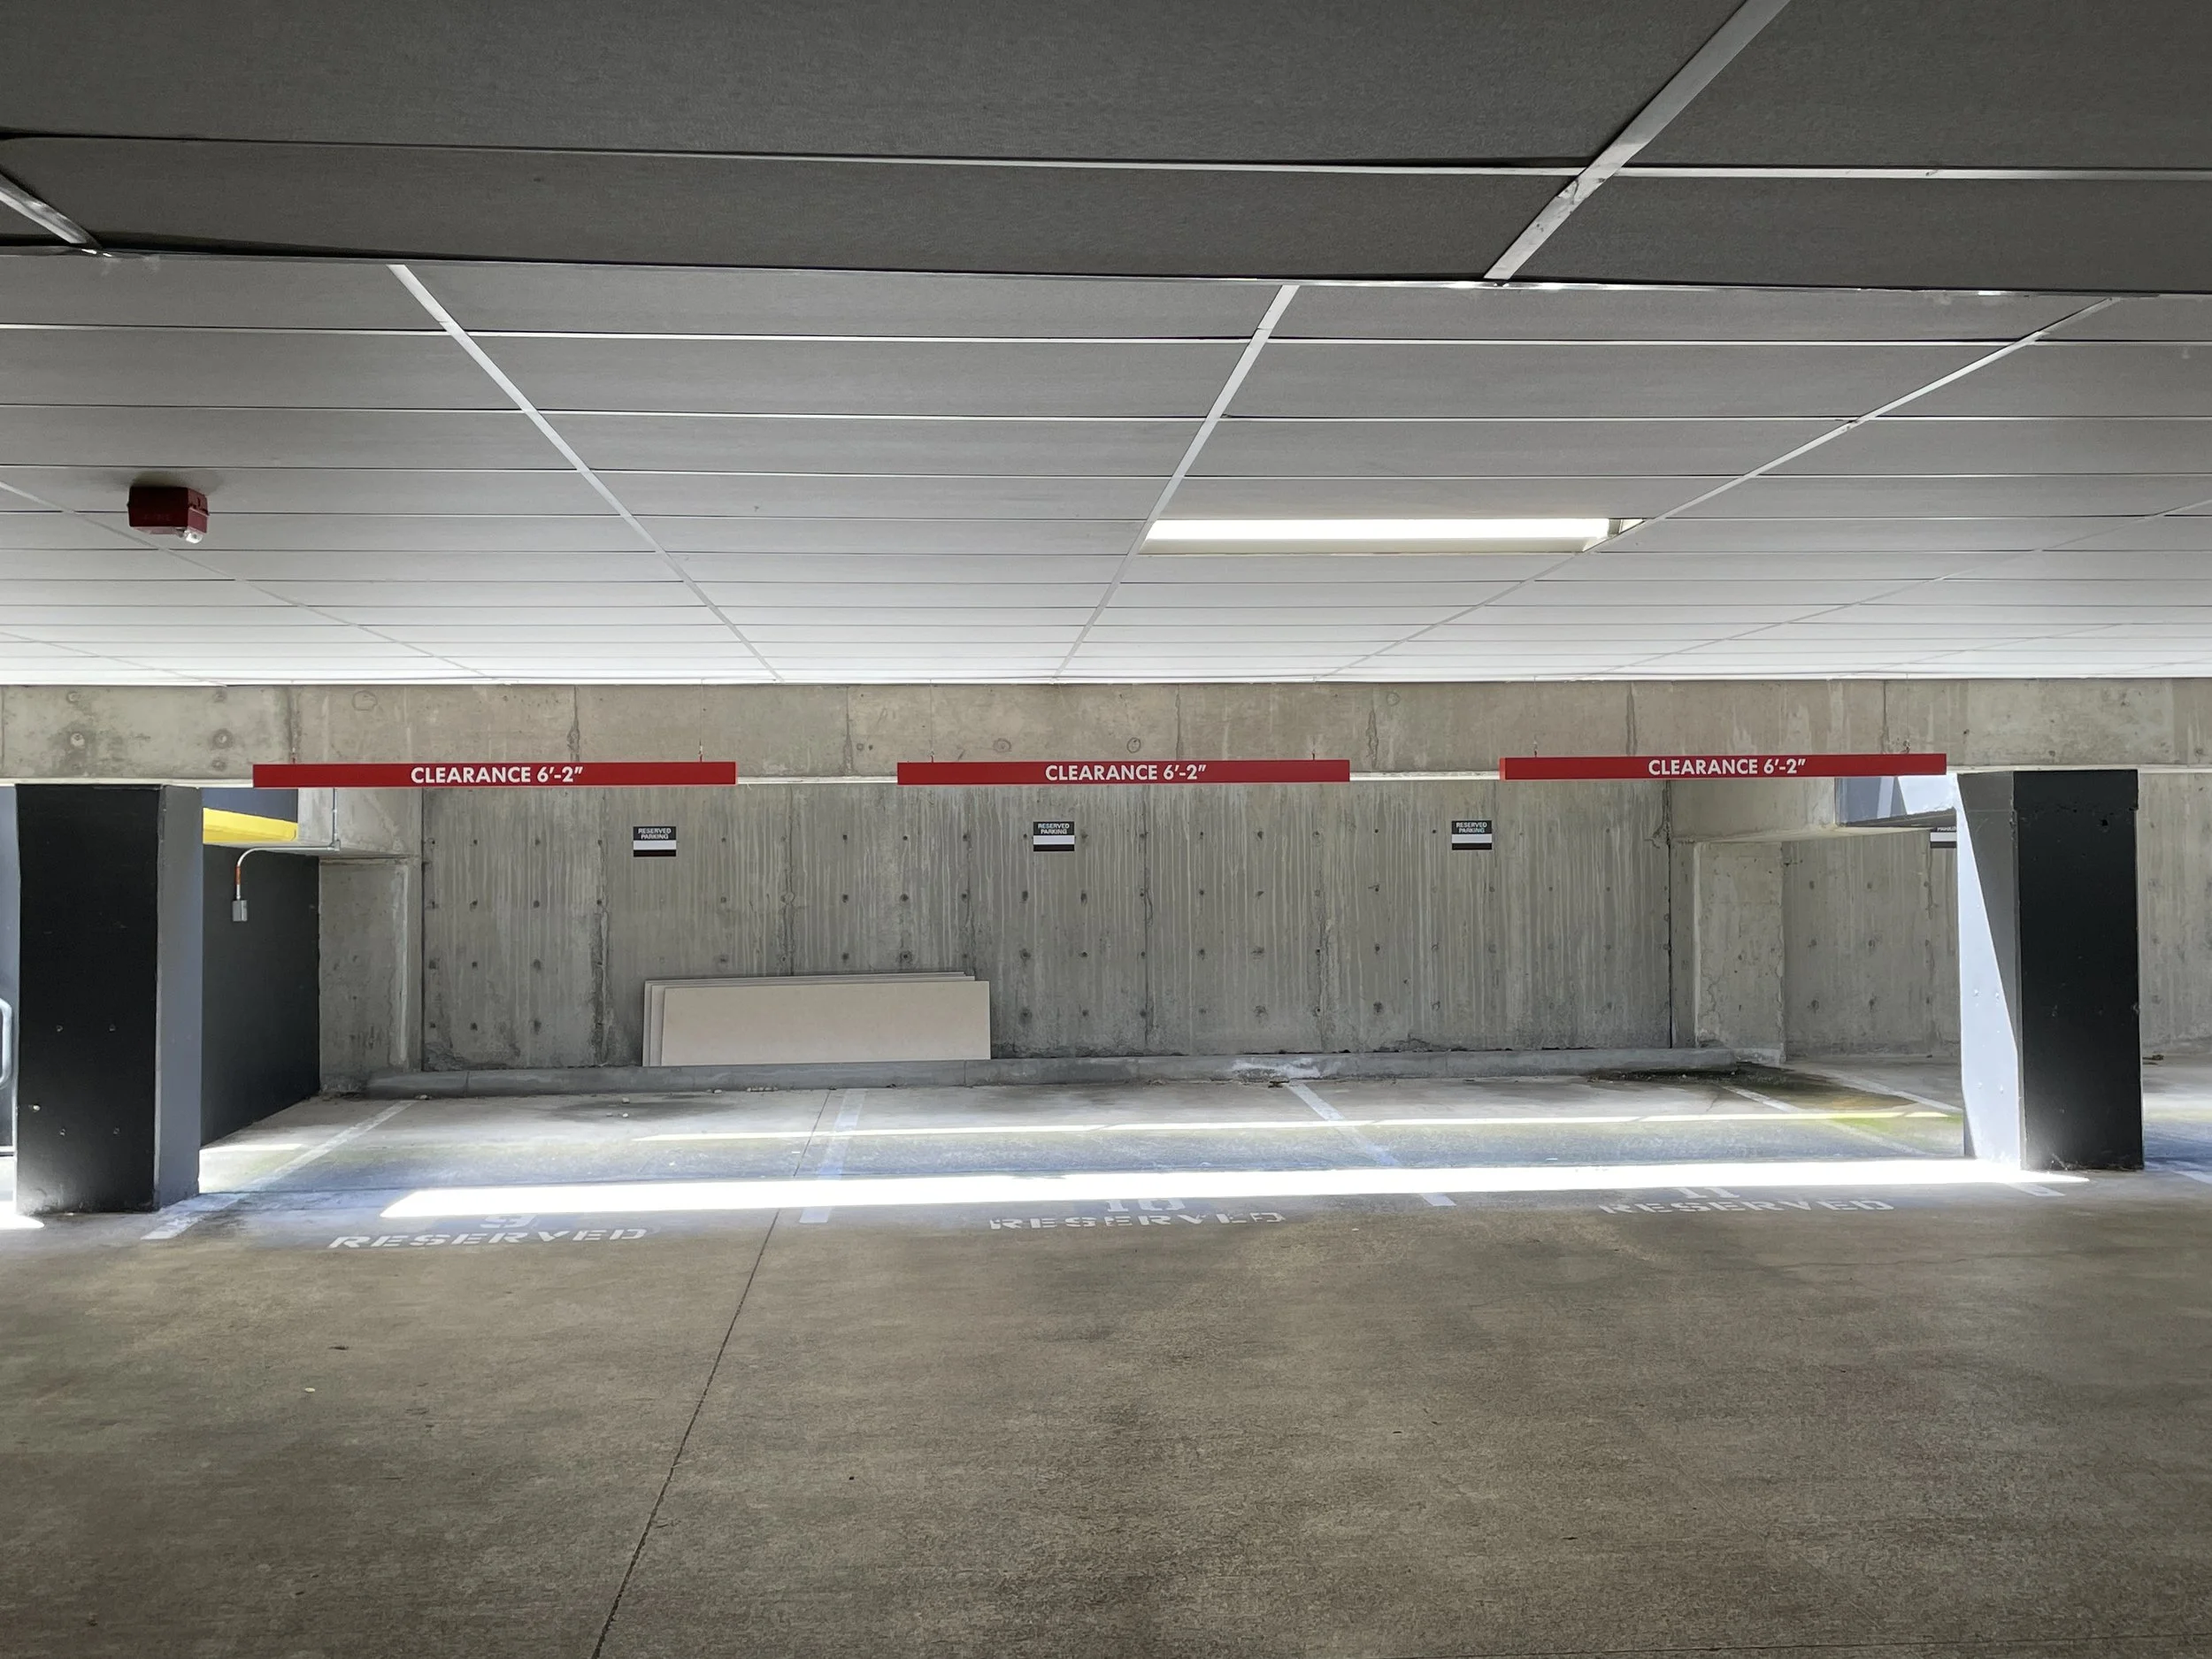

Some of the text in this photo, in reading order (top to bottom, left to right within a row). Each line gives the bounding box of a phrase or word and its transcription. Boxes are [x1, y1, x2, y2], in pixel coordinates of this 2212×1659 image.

[411, 766, 531, 784] CLEARANCE
[1045, 764, 1157, 781] CLEARANCE
[1647, 759, 1758, 776] CLEARANCE
[1106, 1197, 1187, 1212] 10
[1598, 1199, 1895, 1214] RESERVED
[989, 1211, 1286, 1231] RESERVED
[327, 1228, 648, 1249] RESERVED
